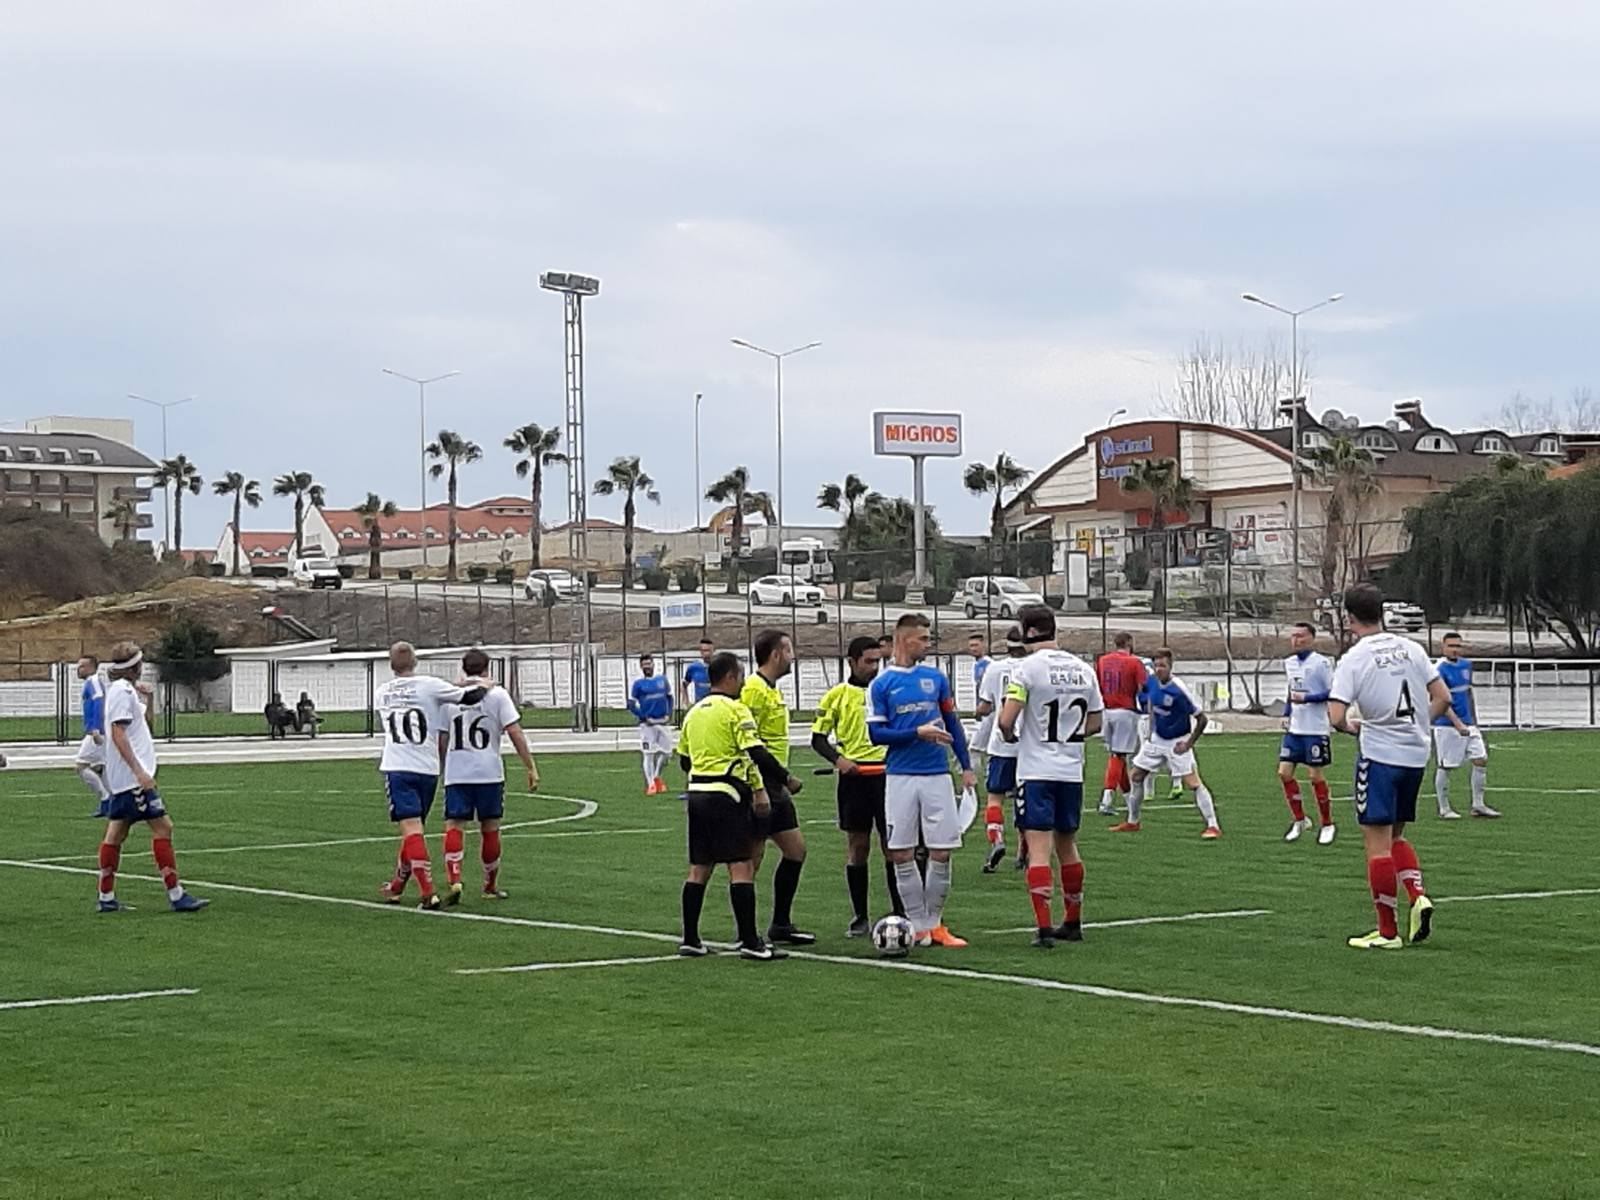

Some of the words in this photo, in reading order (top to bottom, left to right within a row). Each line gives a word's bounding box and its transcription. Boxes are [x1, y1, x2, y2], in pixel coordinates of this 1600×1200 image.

[885, 424, 958, 443] MIGROS
[1040, 697, 1089, 743] 12
[1396, 678, 1416, 725] 4
[386, 708, 428, 745] 10
[449, 714, 491, 752] 16
